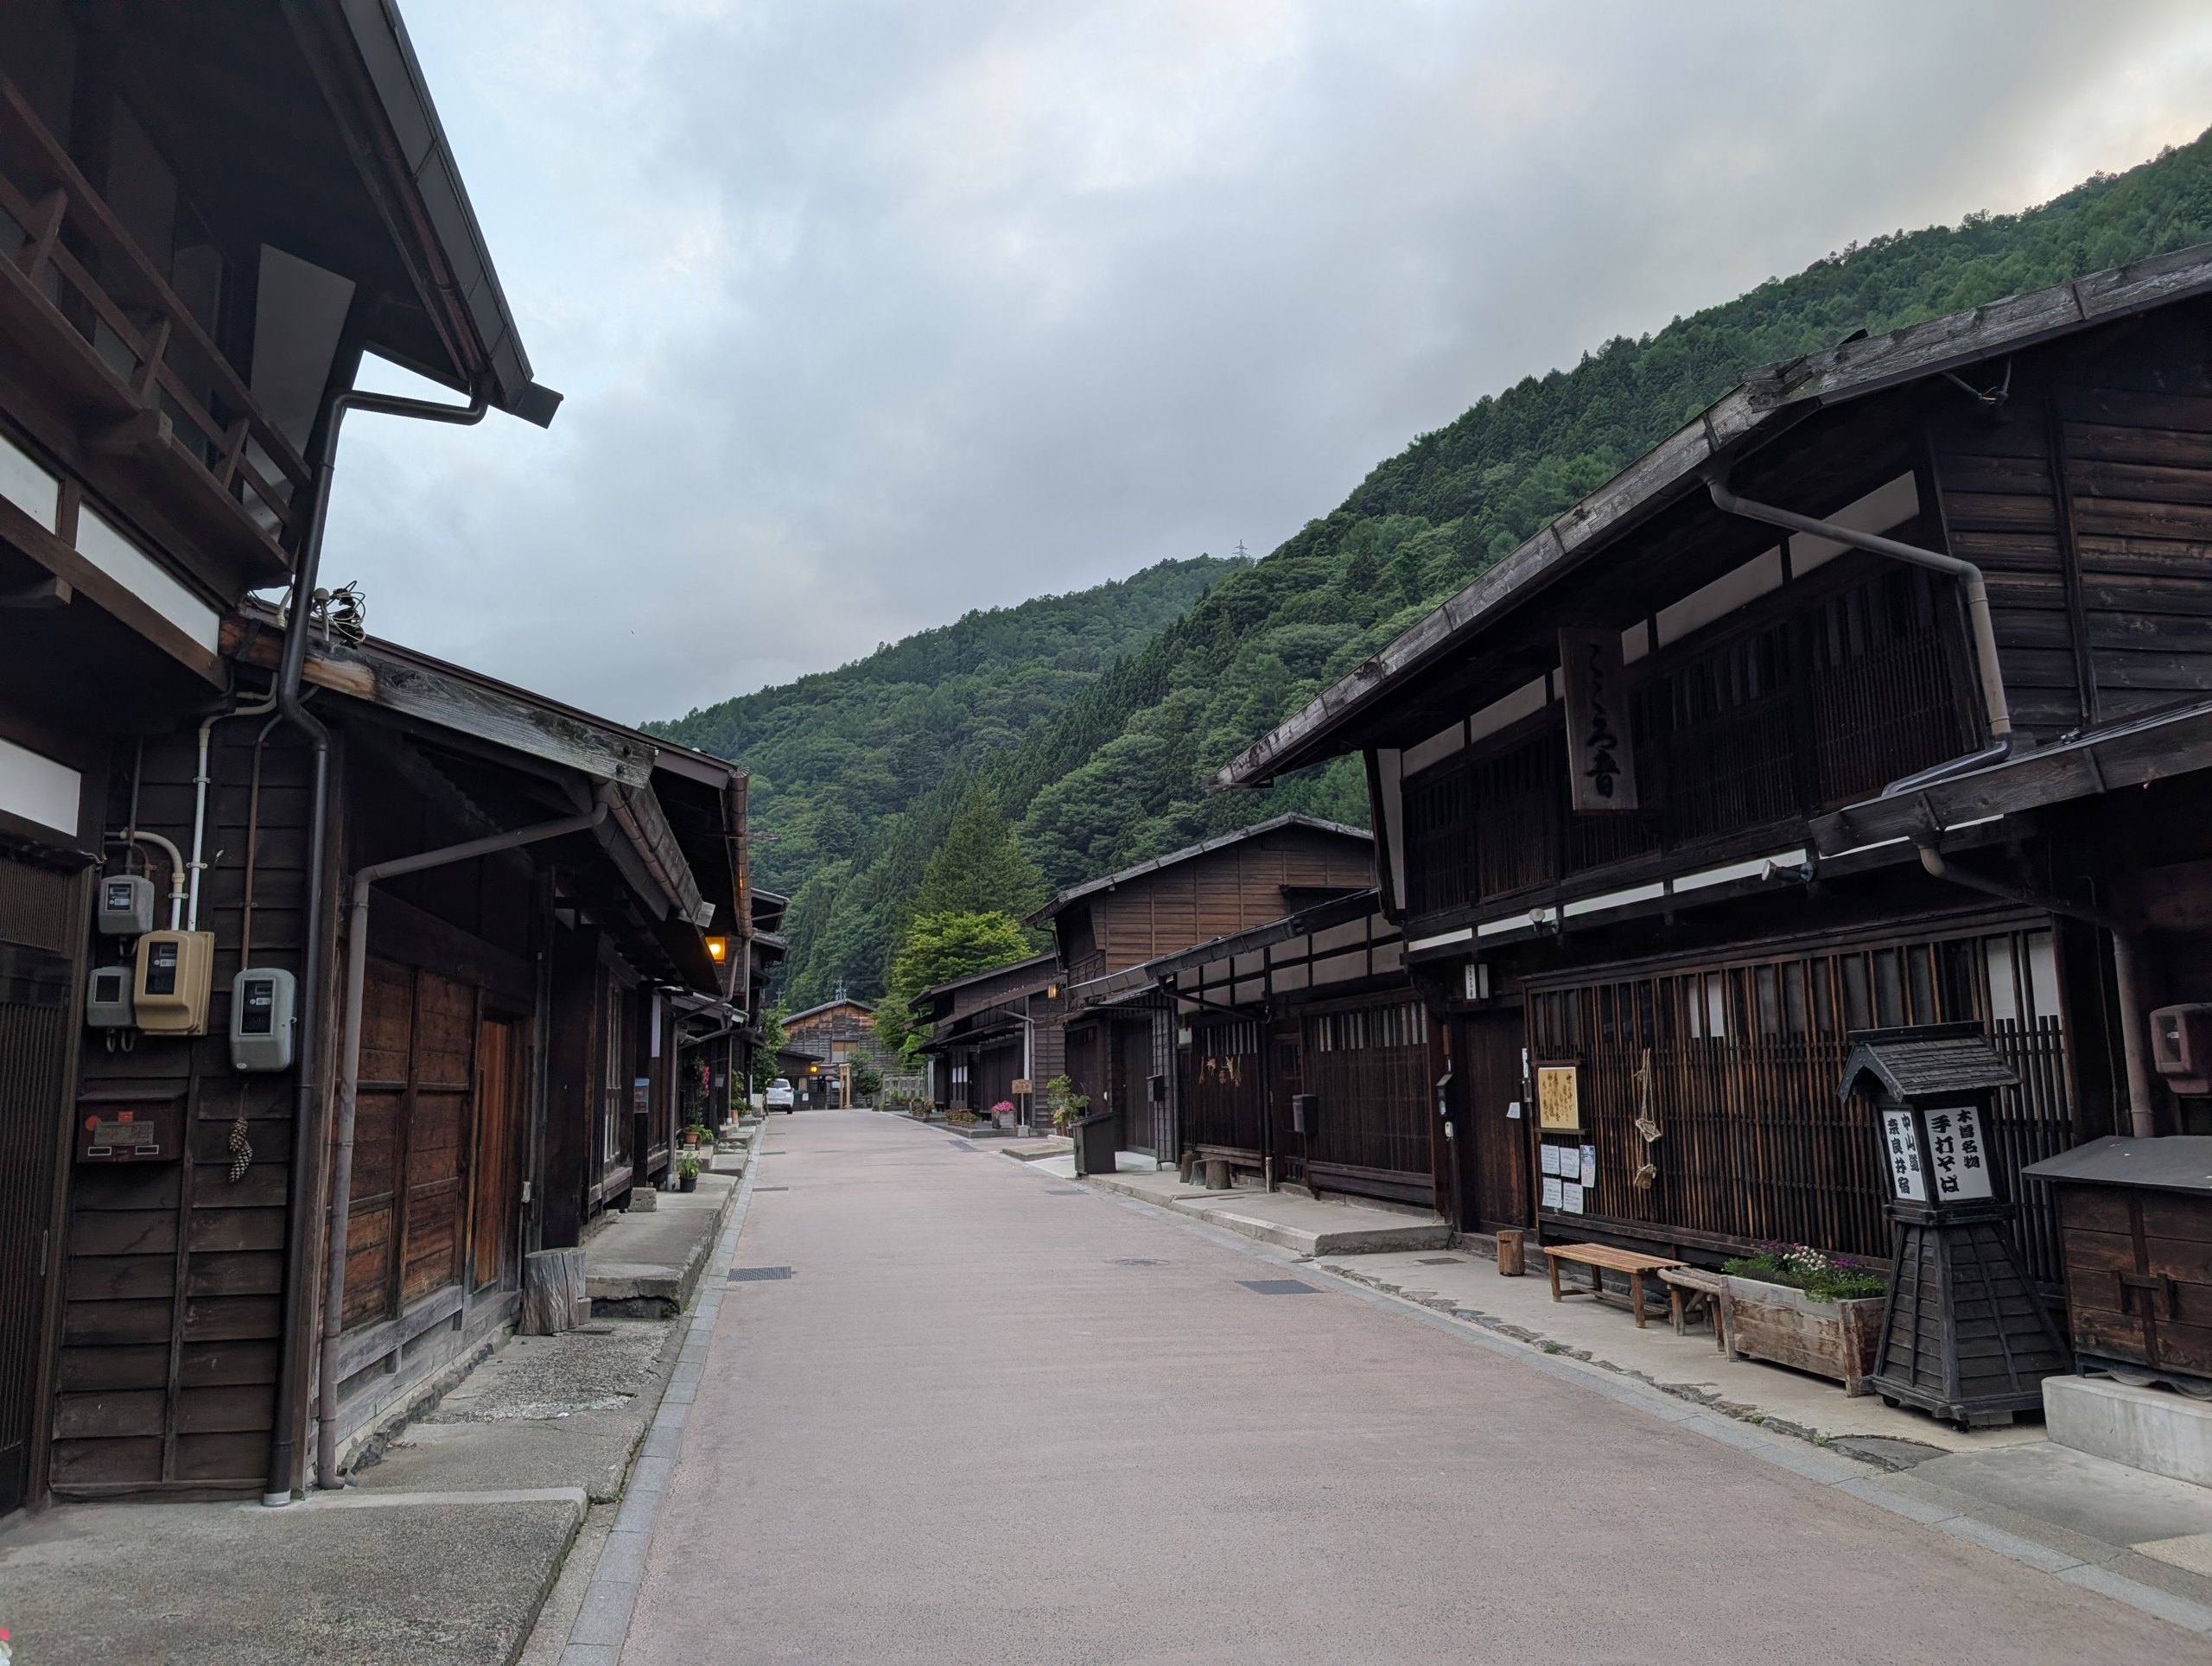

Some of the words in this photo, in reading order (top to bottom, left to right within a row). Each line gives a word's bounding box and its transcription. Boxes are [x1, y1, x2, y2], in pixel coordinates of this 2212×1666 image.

[1887, 1118, 1910, 1194] 奈良井宿
[1901, 1113, 1920, 1173] 中山道
[1931, 1114, 1960, 1193] 手打そば
[1956, 1110, 1980, 1169] 木曽名物
